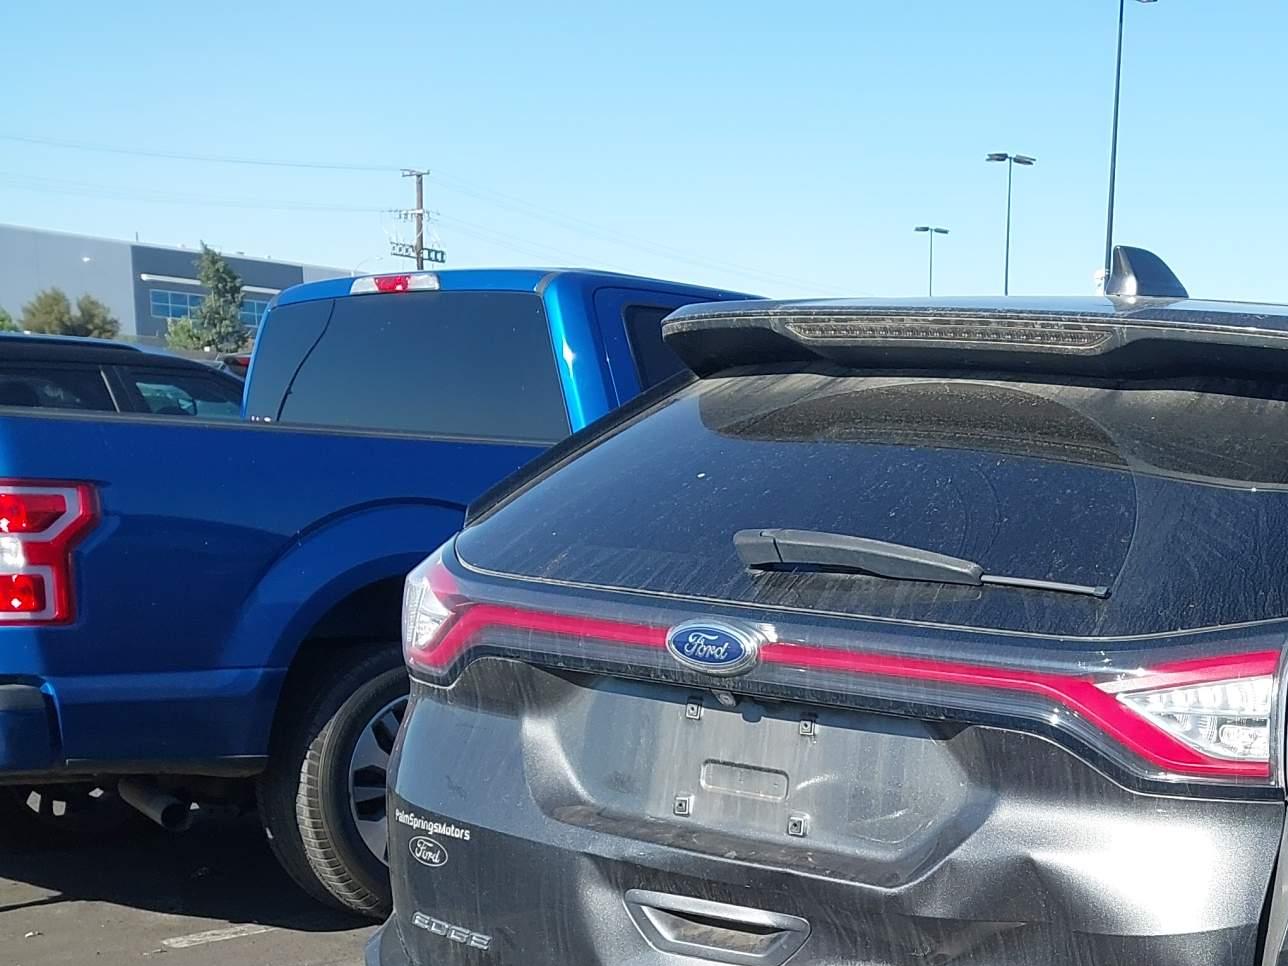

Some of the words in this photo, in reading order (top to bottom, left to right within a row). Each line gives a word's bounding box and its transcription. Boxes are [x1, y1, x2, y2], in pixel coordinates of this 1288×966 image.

[395, 808, 471, 840] PalmSpringsMotors
[415, 839, 441, 864] Ford
[412, 911, 493, 950] EDGE
